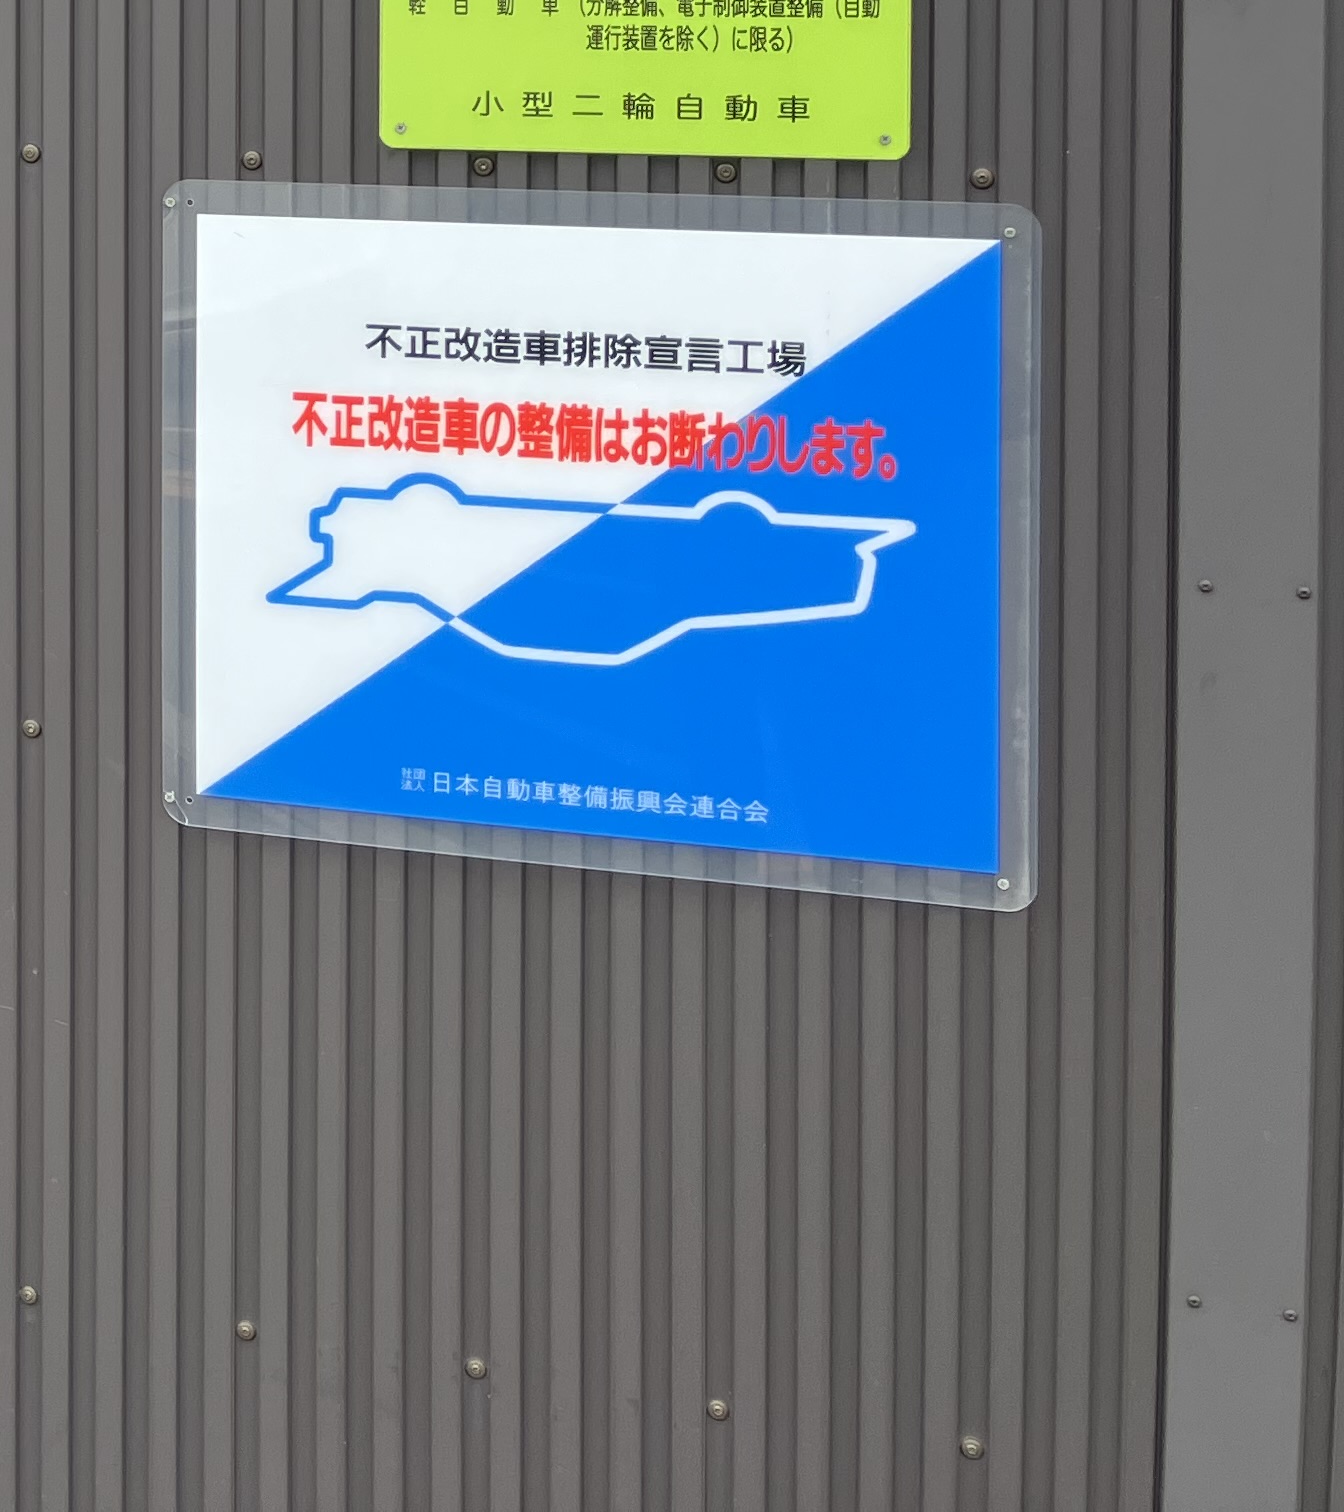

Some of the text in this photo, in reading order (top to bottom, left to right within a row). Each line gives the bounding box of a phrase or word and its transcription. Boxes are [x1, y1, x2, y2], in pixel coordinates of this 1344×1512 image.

[471, 90, 810, 123] 小型二輪自動車
[364, 322, 808, 378] 不正改造車排除宣言工場
[291, 391, 899, 481] 不正改造車の整備はお断わりします。
[433, 771, 769, 824] 日本自動車整備振興会連合会
